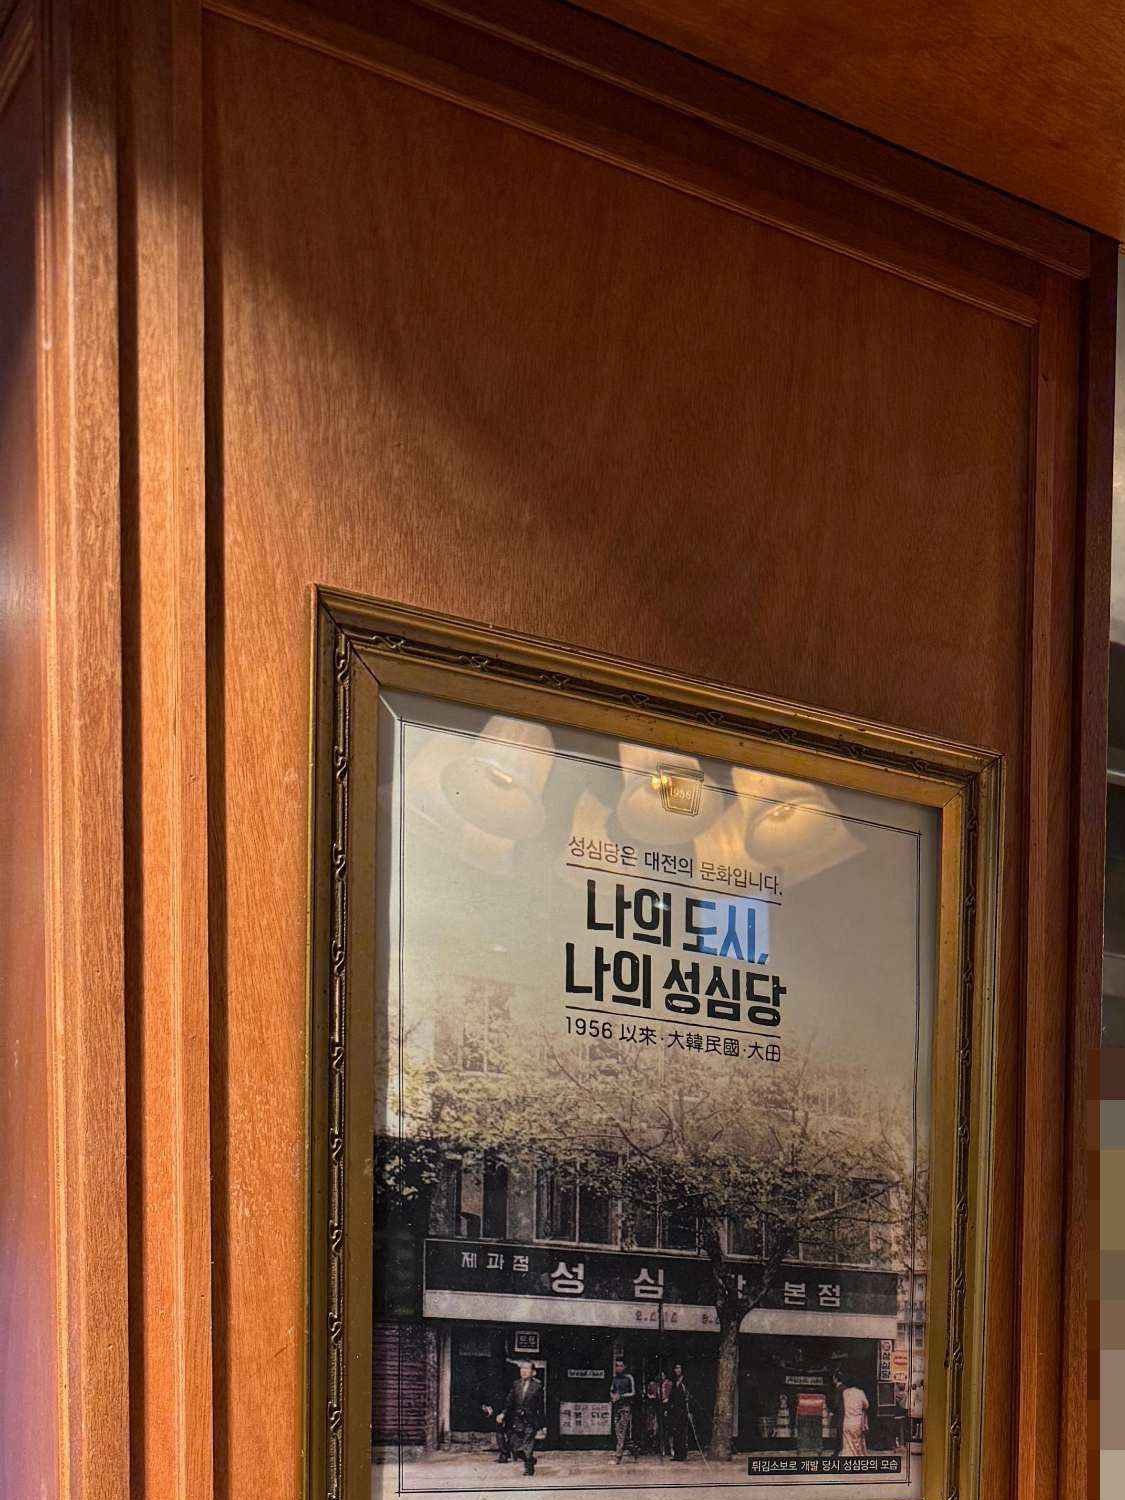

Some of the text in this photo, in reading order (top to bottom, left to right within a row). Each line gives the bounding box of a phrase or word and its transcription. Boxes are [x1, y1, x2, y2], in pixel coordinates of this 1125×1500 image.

[669, 786, 692, 800] 1956
[568, 836, 783, 896] 성심당은 대전의 문화입니다.
[586, 879, 769, 965] 나의 도시,
[565, 942, 787, 1027] 나의 성심당
[566, 1016, 613, 1039] 1956
[751, 1458, 899, 1472] 튀김소보로 개발 당시 성심당의 모습
